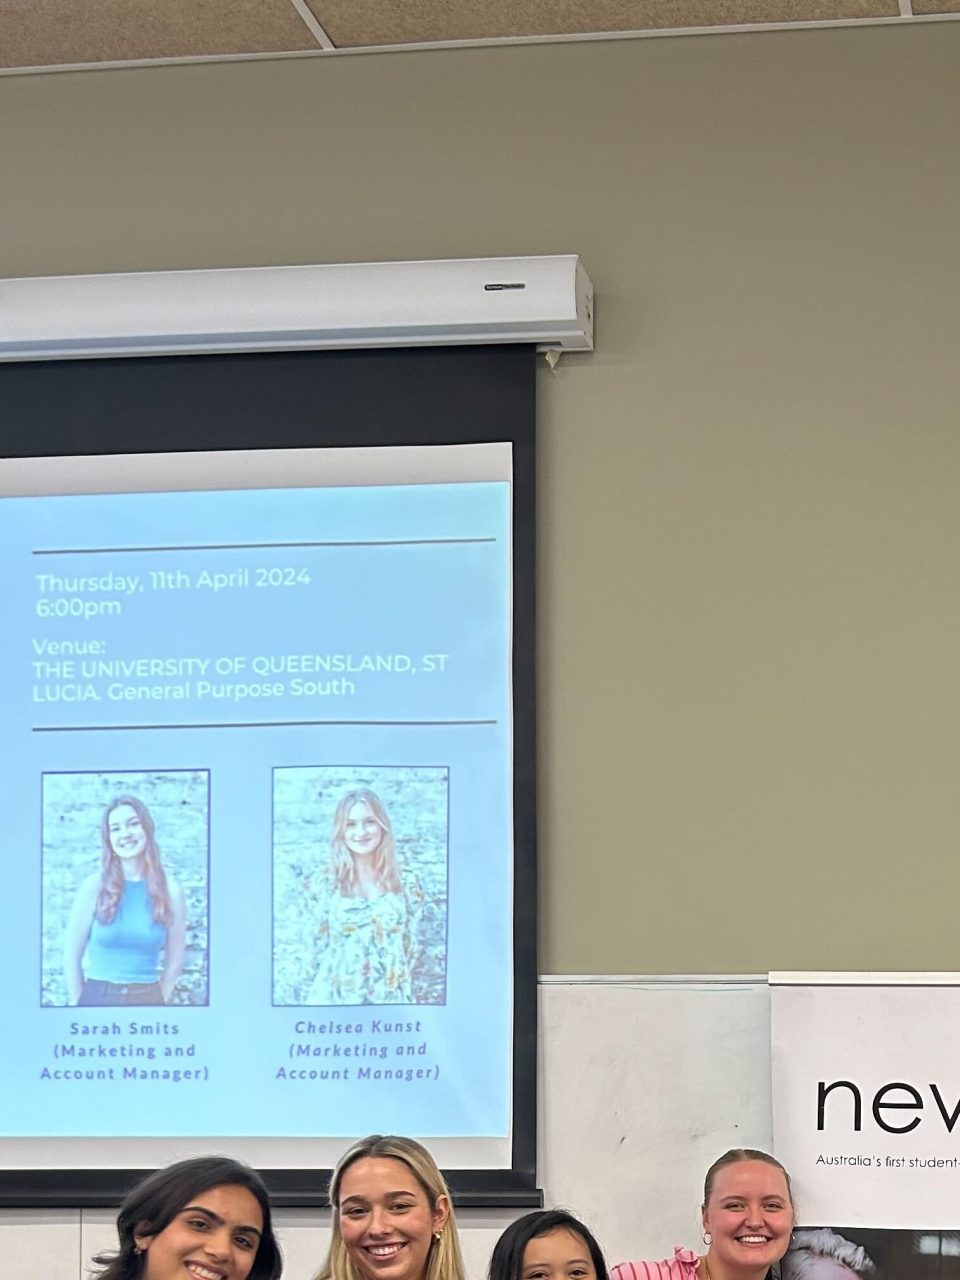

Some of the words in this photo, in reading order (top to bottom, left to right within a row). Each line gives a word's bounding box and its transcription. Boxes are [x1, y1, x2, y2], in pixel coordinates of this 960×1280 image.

[36, 573, 144, 594] Thursday,
[150, 571, 190, 589] 11th
[197, 569, 249, 591] April
[256, 568, 311, 586] 2024
[36, 598, 121, 619] 6:00pm
[32, 638, 106, 655] Venue:
[32, 661, 75, 678] THE
[82, 658, 210, 677] UNIVERSITY
[215, 656, 246, 675] OF
[252, 654, 416, 676] QUEENSLAND,
[422, 654, 449, 672] ST
[108, 681, 190, 700] General
[197, 680, 285, 701] Purpose
[290, 677, 355, 696] South
[70, 1022, 121, 1035] Sarah
[129, 1022, 179, 1035] Smits
[295, 1021, 363, 1034] Chelsea
[372, 1020, 421, 1033] Kunst
[54, 1044, 156, 1059] (Marketing
[164, 1044, 196, 1057] and
[289, 1043, 388, 1058] (Marketing
[396, 1042, 427, 1055] and
[41, 1067, 114, 1079] Account
[123, 1066, 209, 1082] Manager)
[276, 1066, 349, 1079] Account
[357, 1065, 439, 1081] Manager)
[816, 1154, 882, 1168] Australia's
[885, 1156, 905, 1168] first
